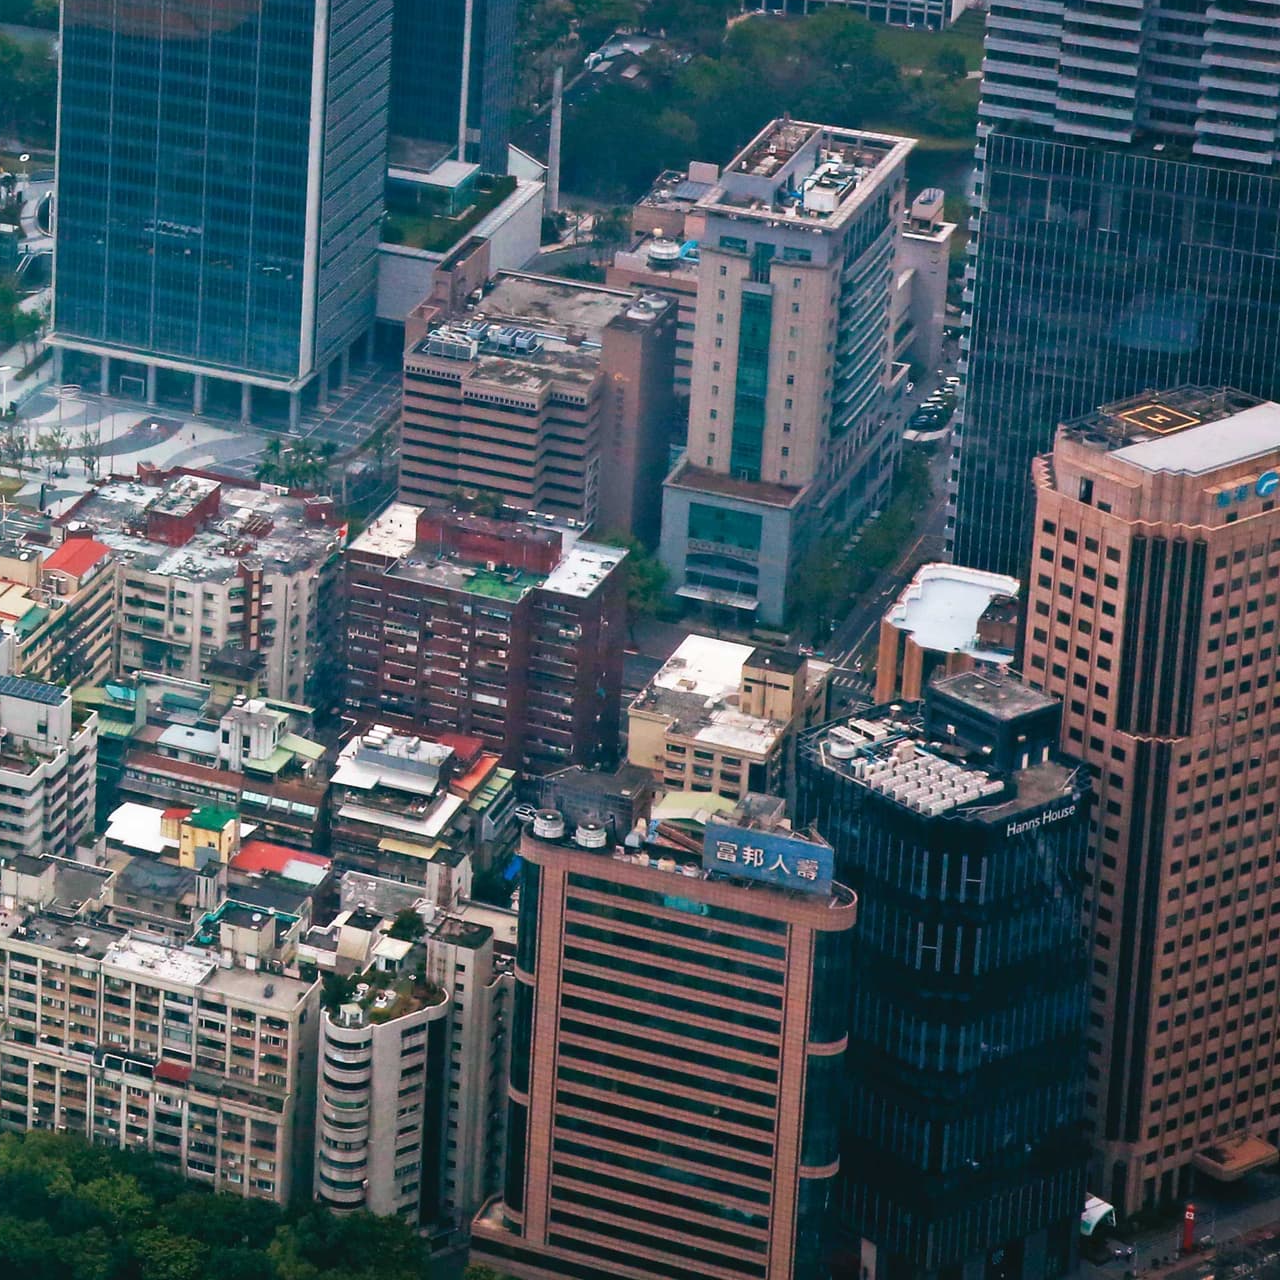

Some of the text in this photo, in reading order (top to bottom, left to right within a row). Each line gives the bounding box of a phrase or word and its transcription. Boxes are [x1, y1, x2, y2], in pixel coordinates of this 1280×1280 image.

[1006, 805, 1076, 837] Hanns House
[716, 840, 819, 880] 富邦人壽
